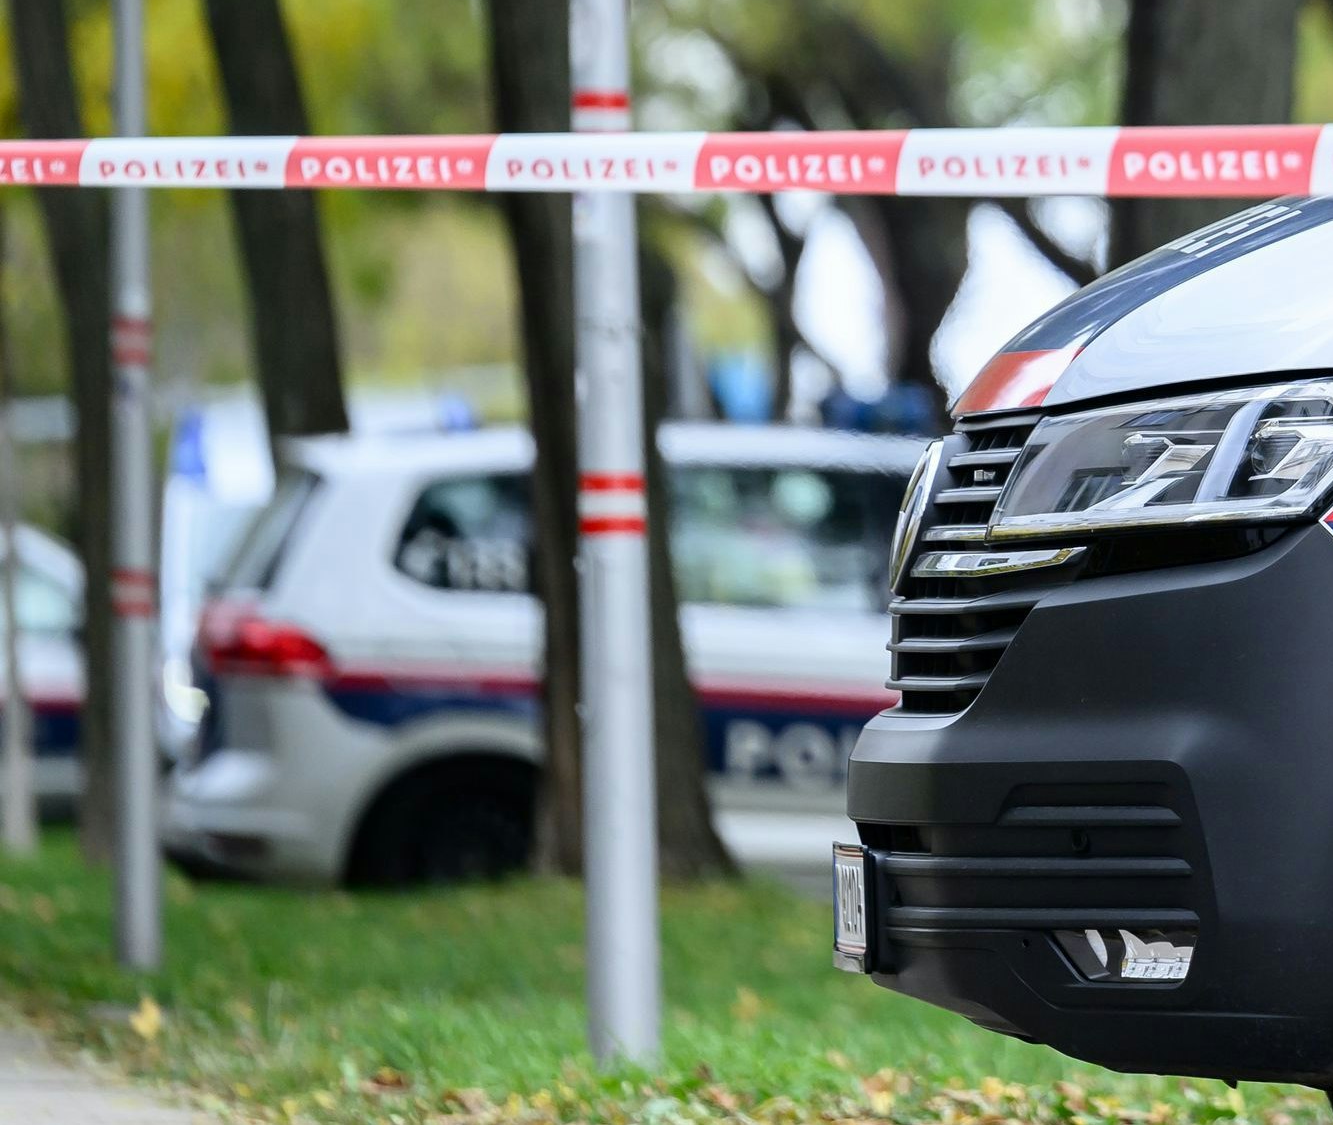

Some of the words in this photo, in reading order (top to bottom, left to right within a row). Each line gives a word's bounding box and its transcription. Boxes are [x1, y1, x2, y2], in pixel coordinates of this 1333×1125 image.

[99, 159, 248, 179] POLIZEI
[302, 156, 450, 183] POLIZEI
[507, 159, 653, 180] POLIZEI
[709, 156, 861, 183] POLIZEI
[919, 156, 1068, 178] POLIZEI
[1124, 150, 1276, 181] POLIZEI
